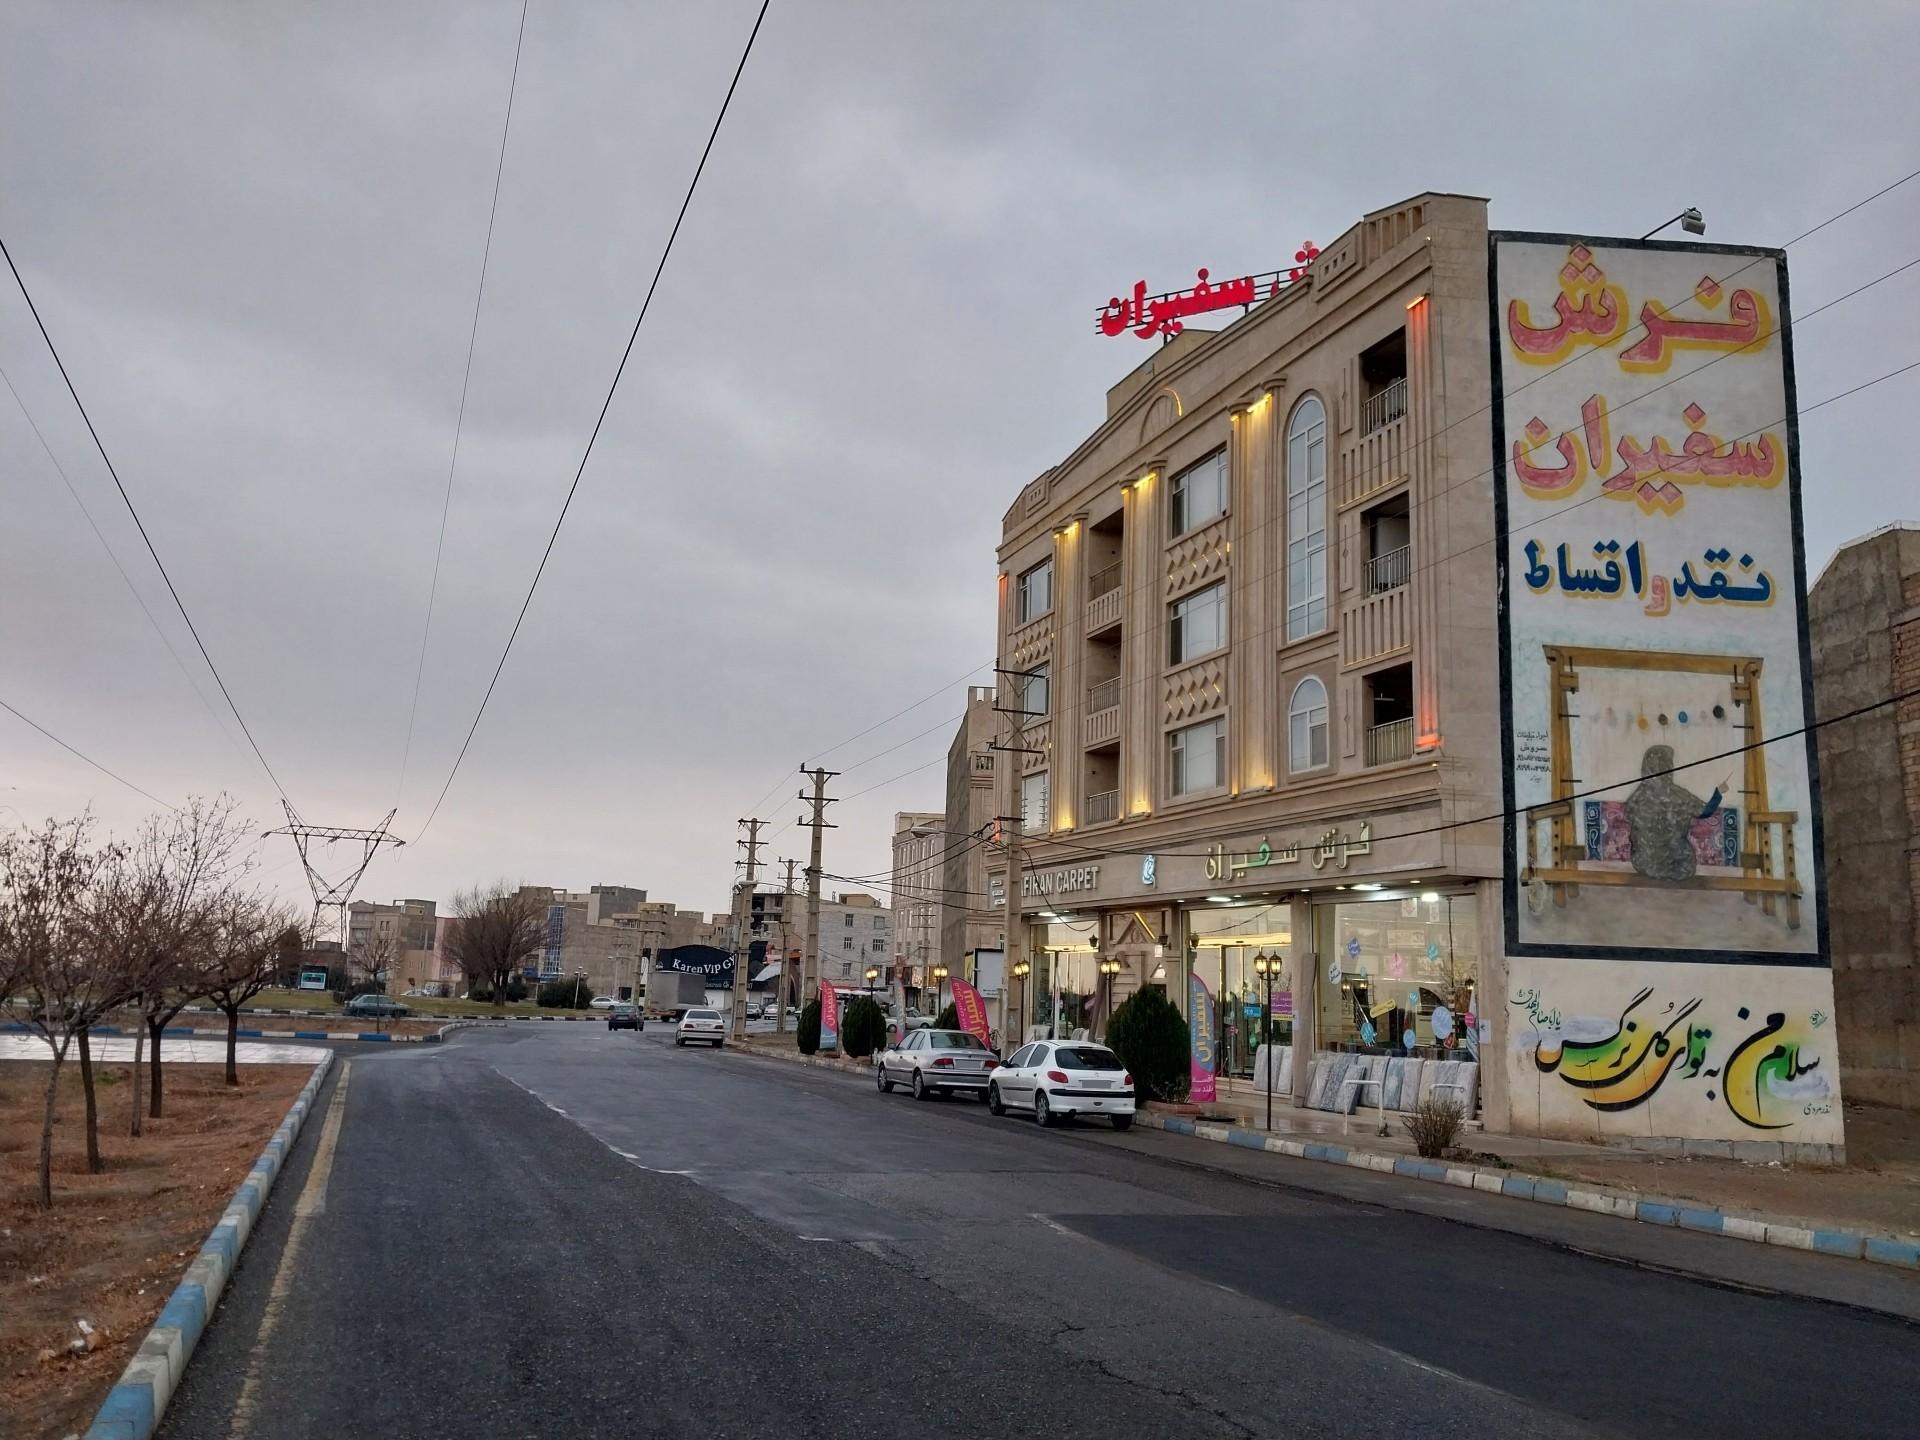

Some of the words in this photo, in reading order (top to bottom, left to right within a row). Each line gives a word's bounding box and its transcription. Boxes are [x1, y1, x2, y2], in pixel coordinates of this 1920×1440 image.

[1102, 268, 1255, 339] سفیران
[1508, 243, 1770, 372] فرش
[1512, 394, 1784, 515] سفیران
[1523, 538, 1643, 600] اقساط
[1644, 574, 1670, 616] و
[1673, 547, 1774, 605] نقد
[1205, 836, 1298, 881] سفیران
[1311, 820, 1372, 869] فرش
[1056, 866, 1099, 893] CARPET
[672, 958, 703, 974] Karen
[722, 953, 737, 969] GY
[1196, 992, 1213, 1062] سفیران
[1534, 987, 1655, 1075] نرگس
[1683, 1027, 1713, 1080] تو
[1702, 1066, 1721, 1101] به
[1722, 1006, 1795, 1130] من
[1756, 1044, 1821, 1118] سلام
